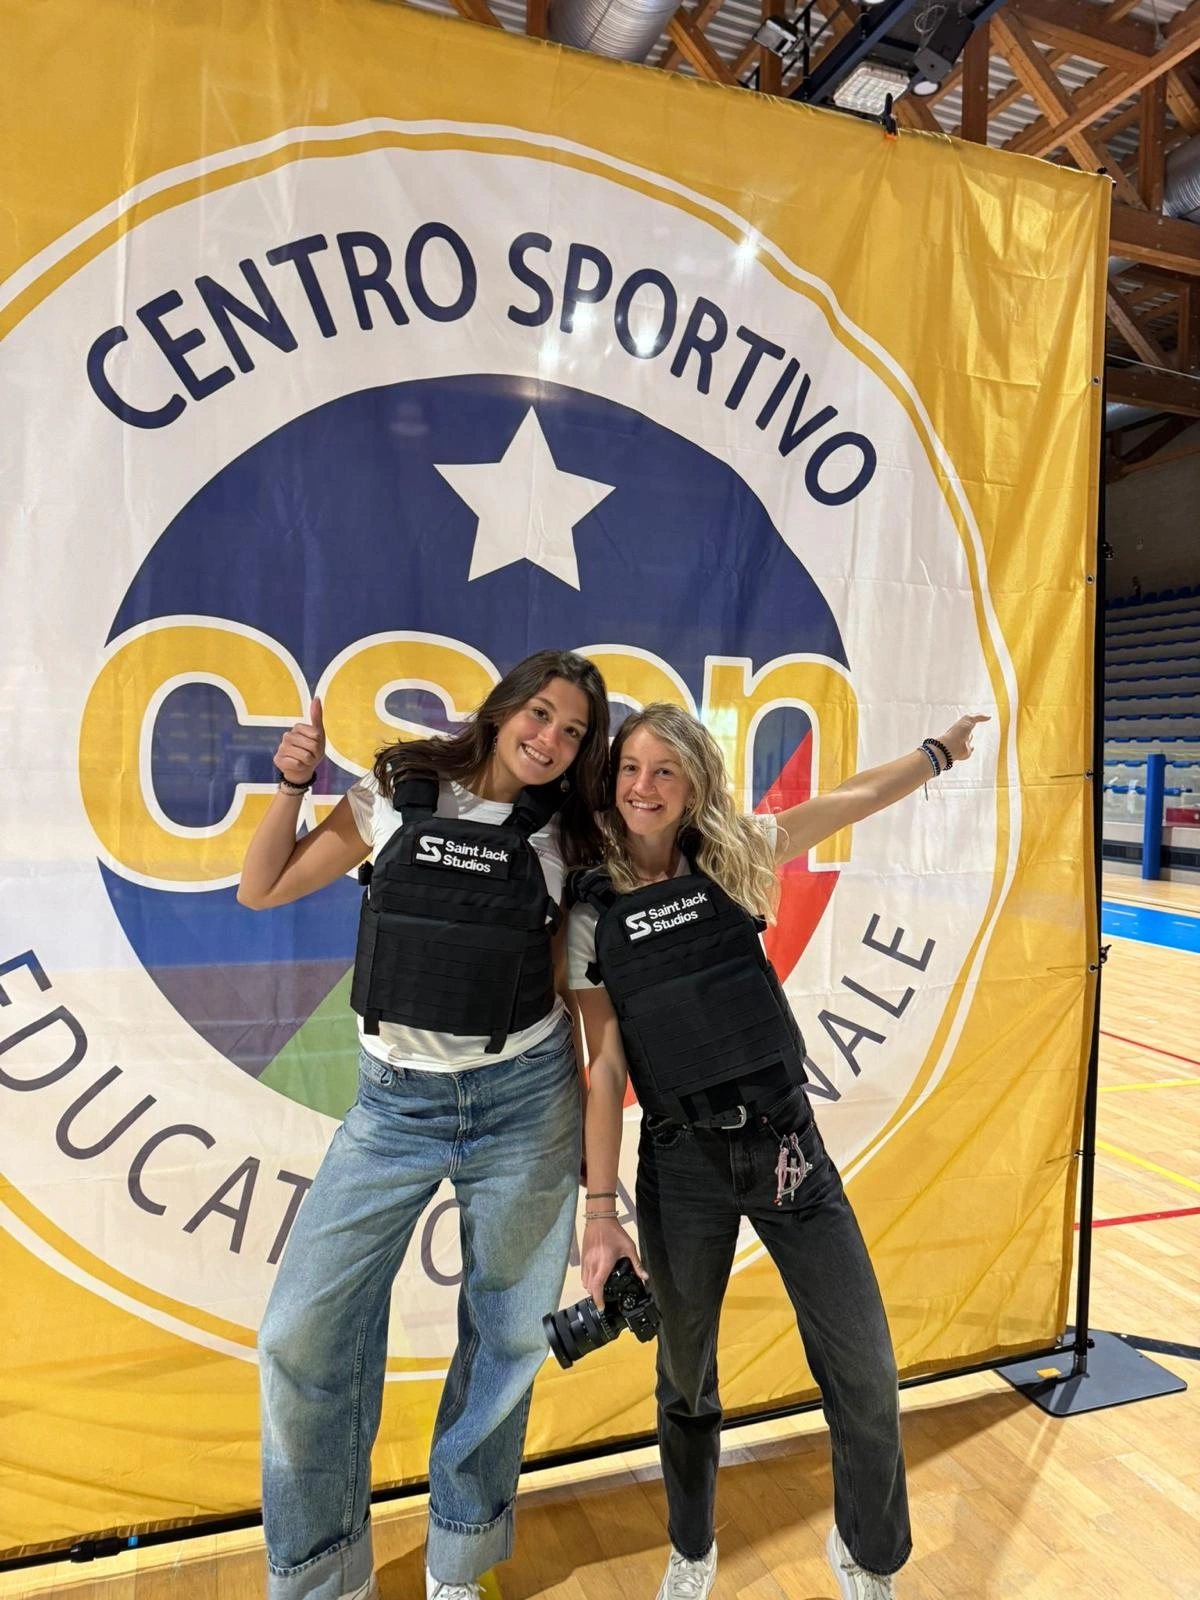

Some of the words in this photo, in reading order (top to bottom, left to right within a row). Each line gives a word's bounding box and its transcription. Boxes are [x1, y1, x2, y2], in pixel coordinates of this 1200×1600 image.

[86, 221, 477, 429] CENTRO
[507, 231, 878, 507] SPORTIVO
[445, 840, 479, 857] Saint
[480, 846, 509, 862] Jack
[442, 854, 491, 873] Studios
[648, 901, 680, 919] Saint
[681, 892, 708, 909] Jack
[653, 910, 698, 932] Studios
